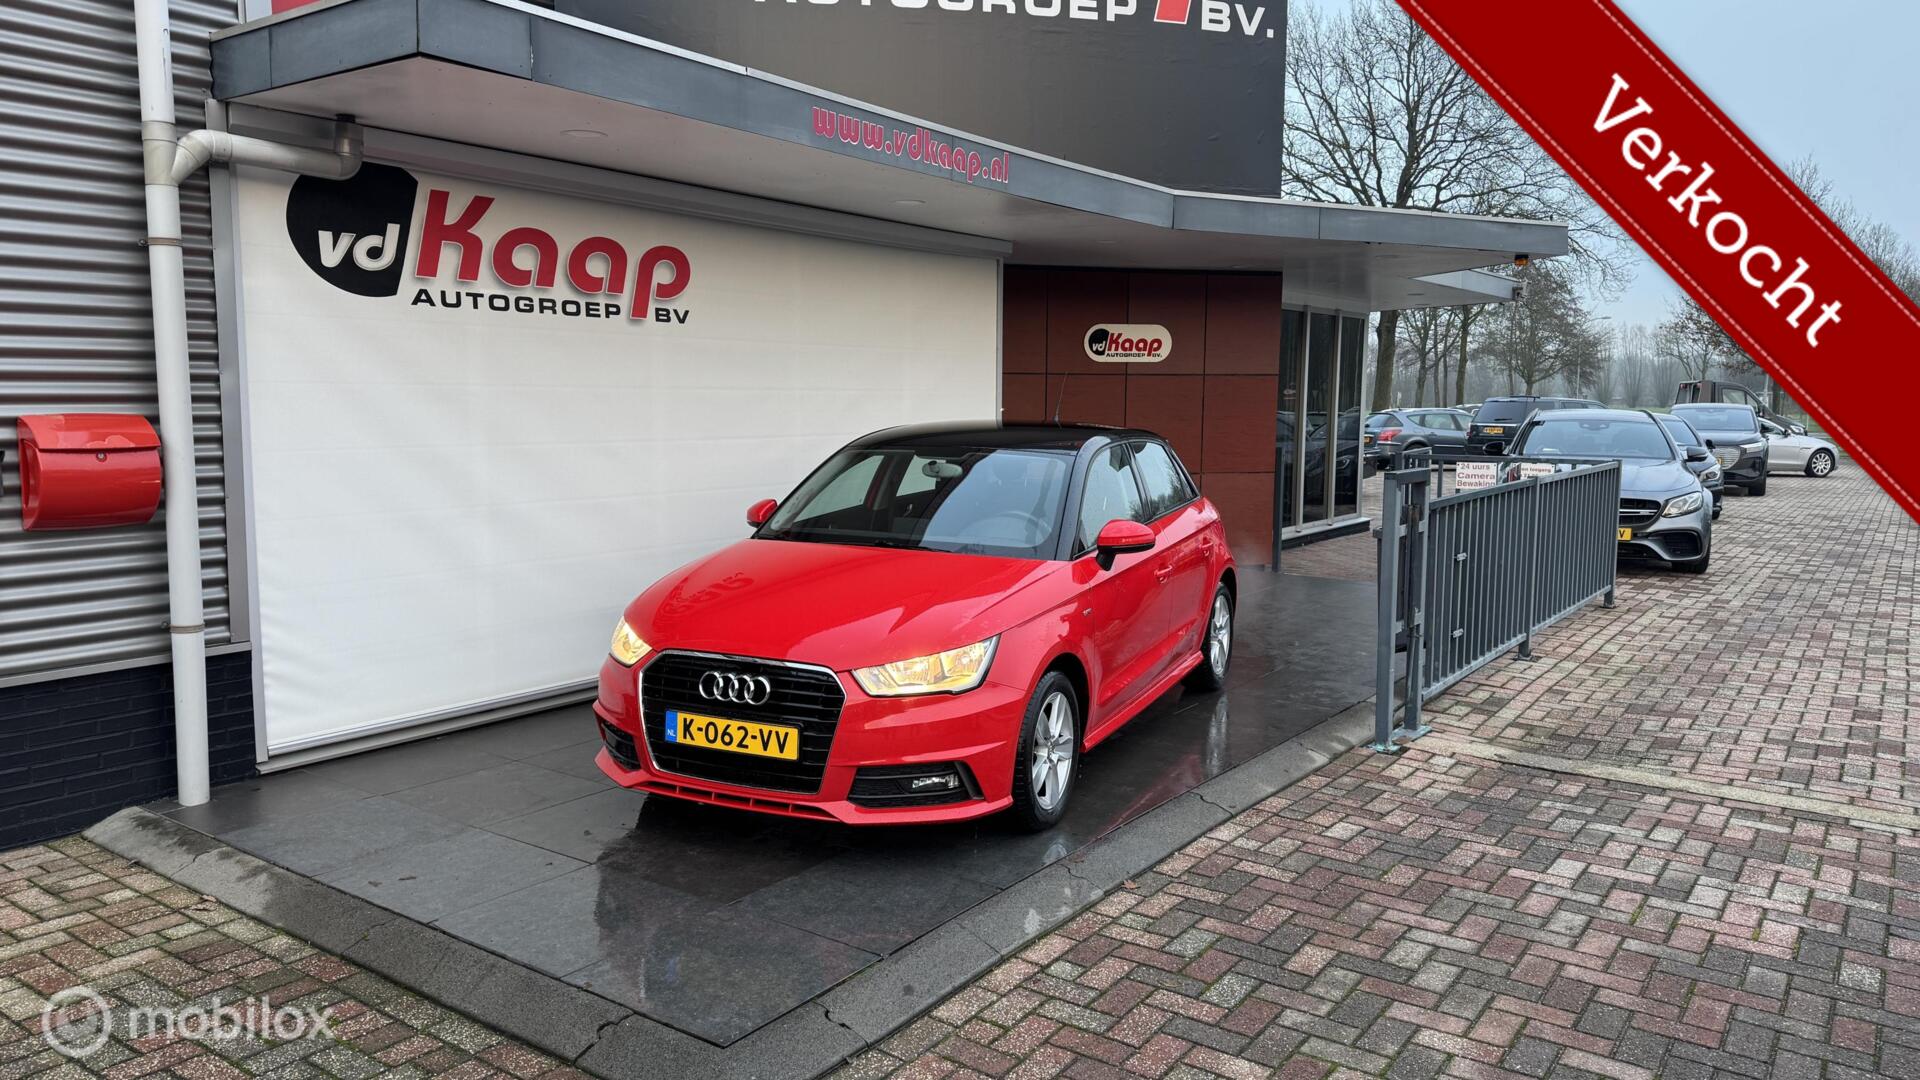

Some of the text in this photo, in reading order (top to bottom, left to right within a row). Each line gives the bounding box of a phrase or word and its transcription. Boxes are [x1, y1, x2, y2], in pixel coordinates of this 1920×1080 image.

[1201, 0, 1274, 38] BV.
[811, 106, 1010, 184] www.vdkaap.nl
[317, 188, 691, 320] vd Kaap
[411, 288, 690, 325] AUTOGROEP BV
[1107, 332, 1163, 357] Kaap
[667, 717, 789, 754] NL K-062-VV
